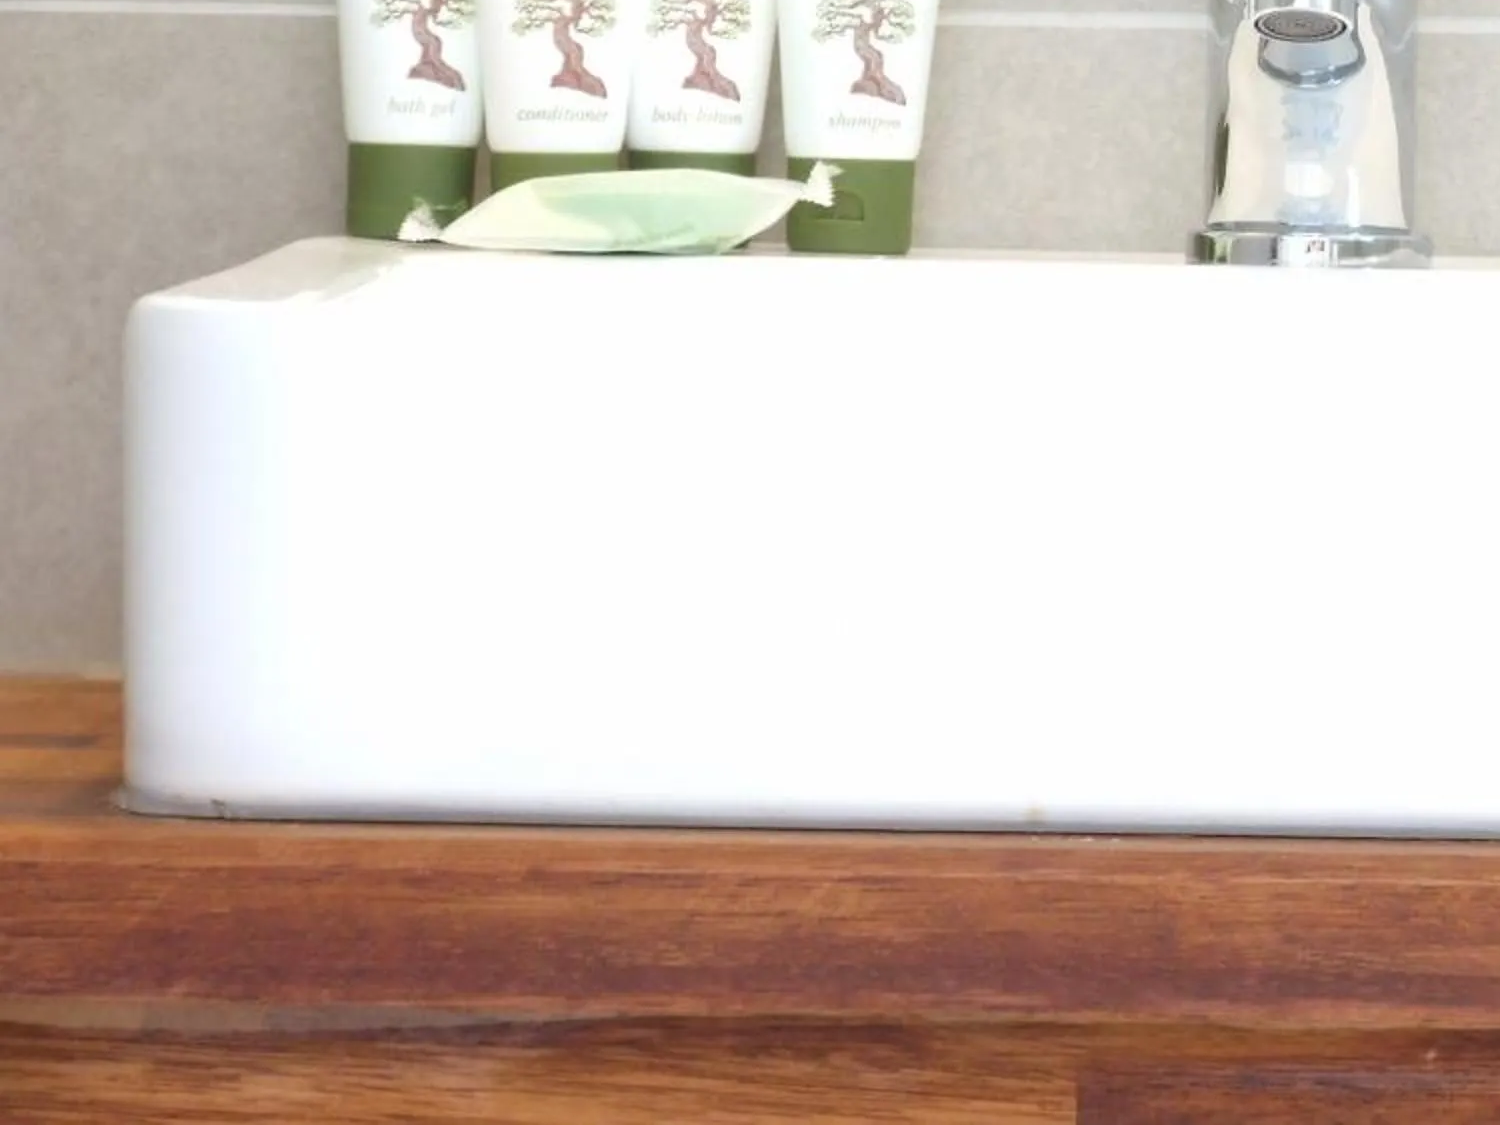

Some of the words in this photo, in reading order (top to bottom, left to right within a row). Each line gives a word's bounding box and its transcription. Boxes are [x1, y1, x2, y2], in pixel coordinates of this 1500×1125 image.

[386, 96, 426, 116] bath
[429, 98, 456, 119] gel
[515, 104, 609, 123] conditioner
[650, 104, 688, 128] body
[694, 106, 743, 125] lotion
[827, 111, 901, 133] shampoo
